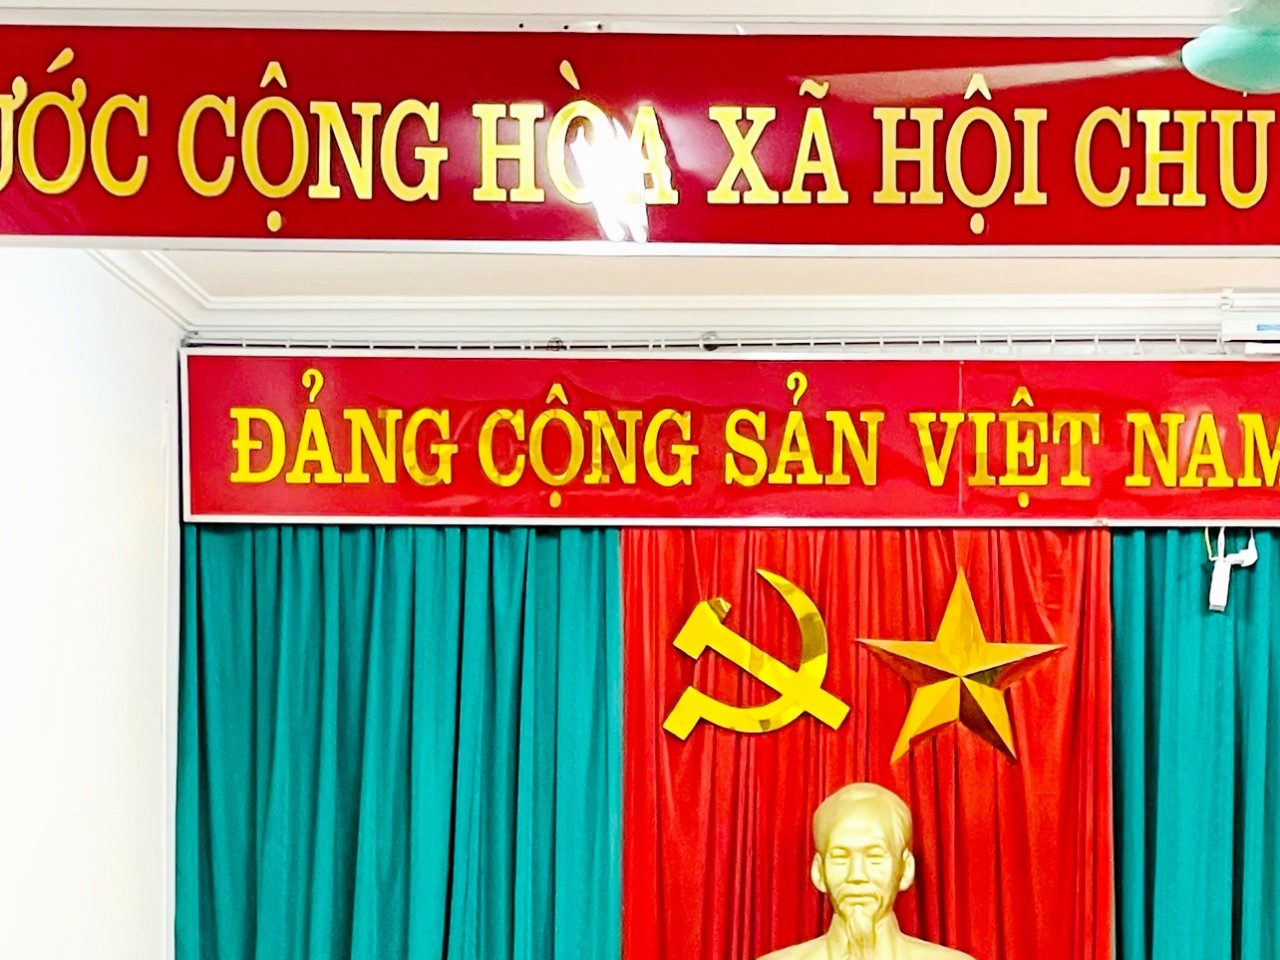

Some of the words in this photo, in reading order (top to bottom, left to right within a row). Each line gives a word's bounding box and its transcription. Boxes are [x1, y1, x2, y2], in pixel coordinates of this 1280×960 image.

[176, 61, 449, 233] CỘNG
[472, 59, 680, 206] HÒA
[707, 82, 849, 206] XÃ
[872, 72, 1049, 235] HỘI
[229, 369, 459, 487] ĐẢNG
[478, 383, 699, 508] CỘNG
[724, 371, 885, 487] SẢN
[909, 386, 1100, 508] VIỆT
